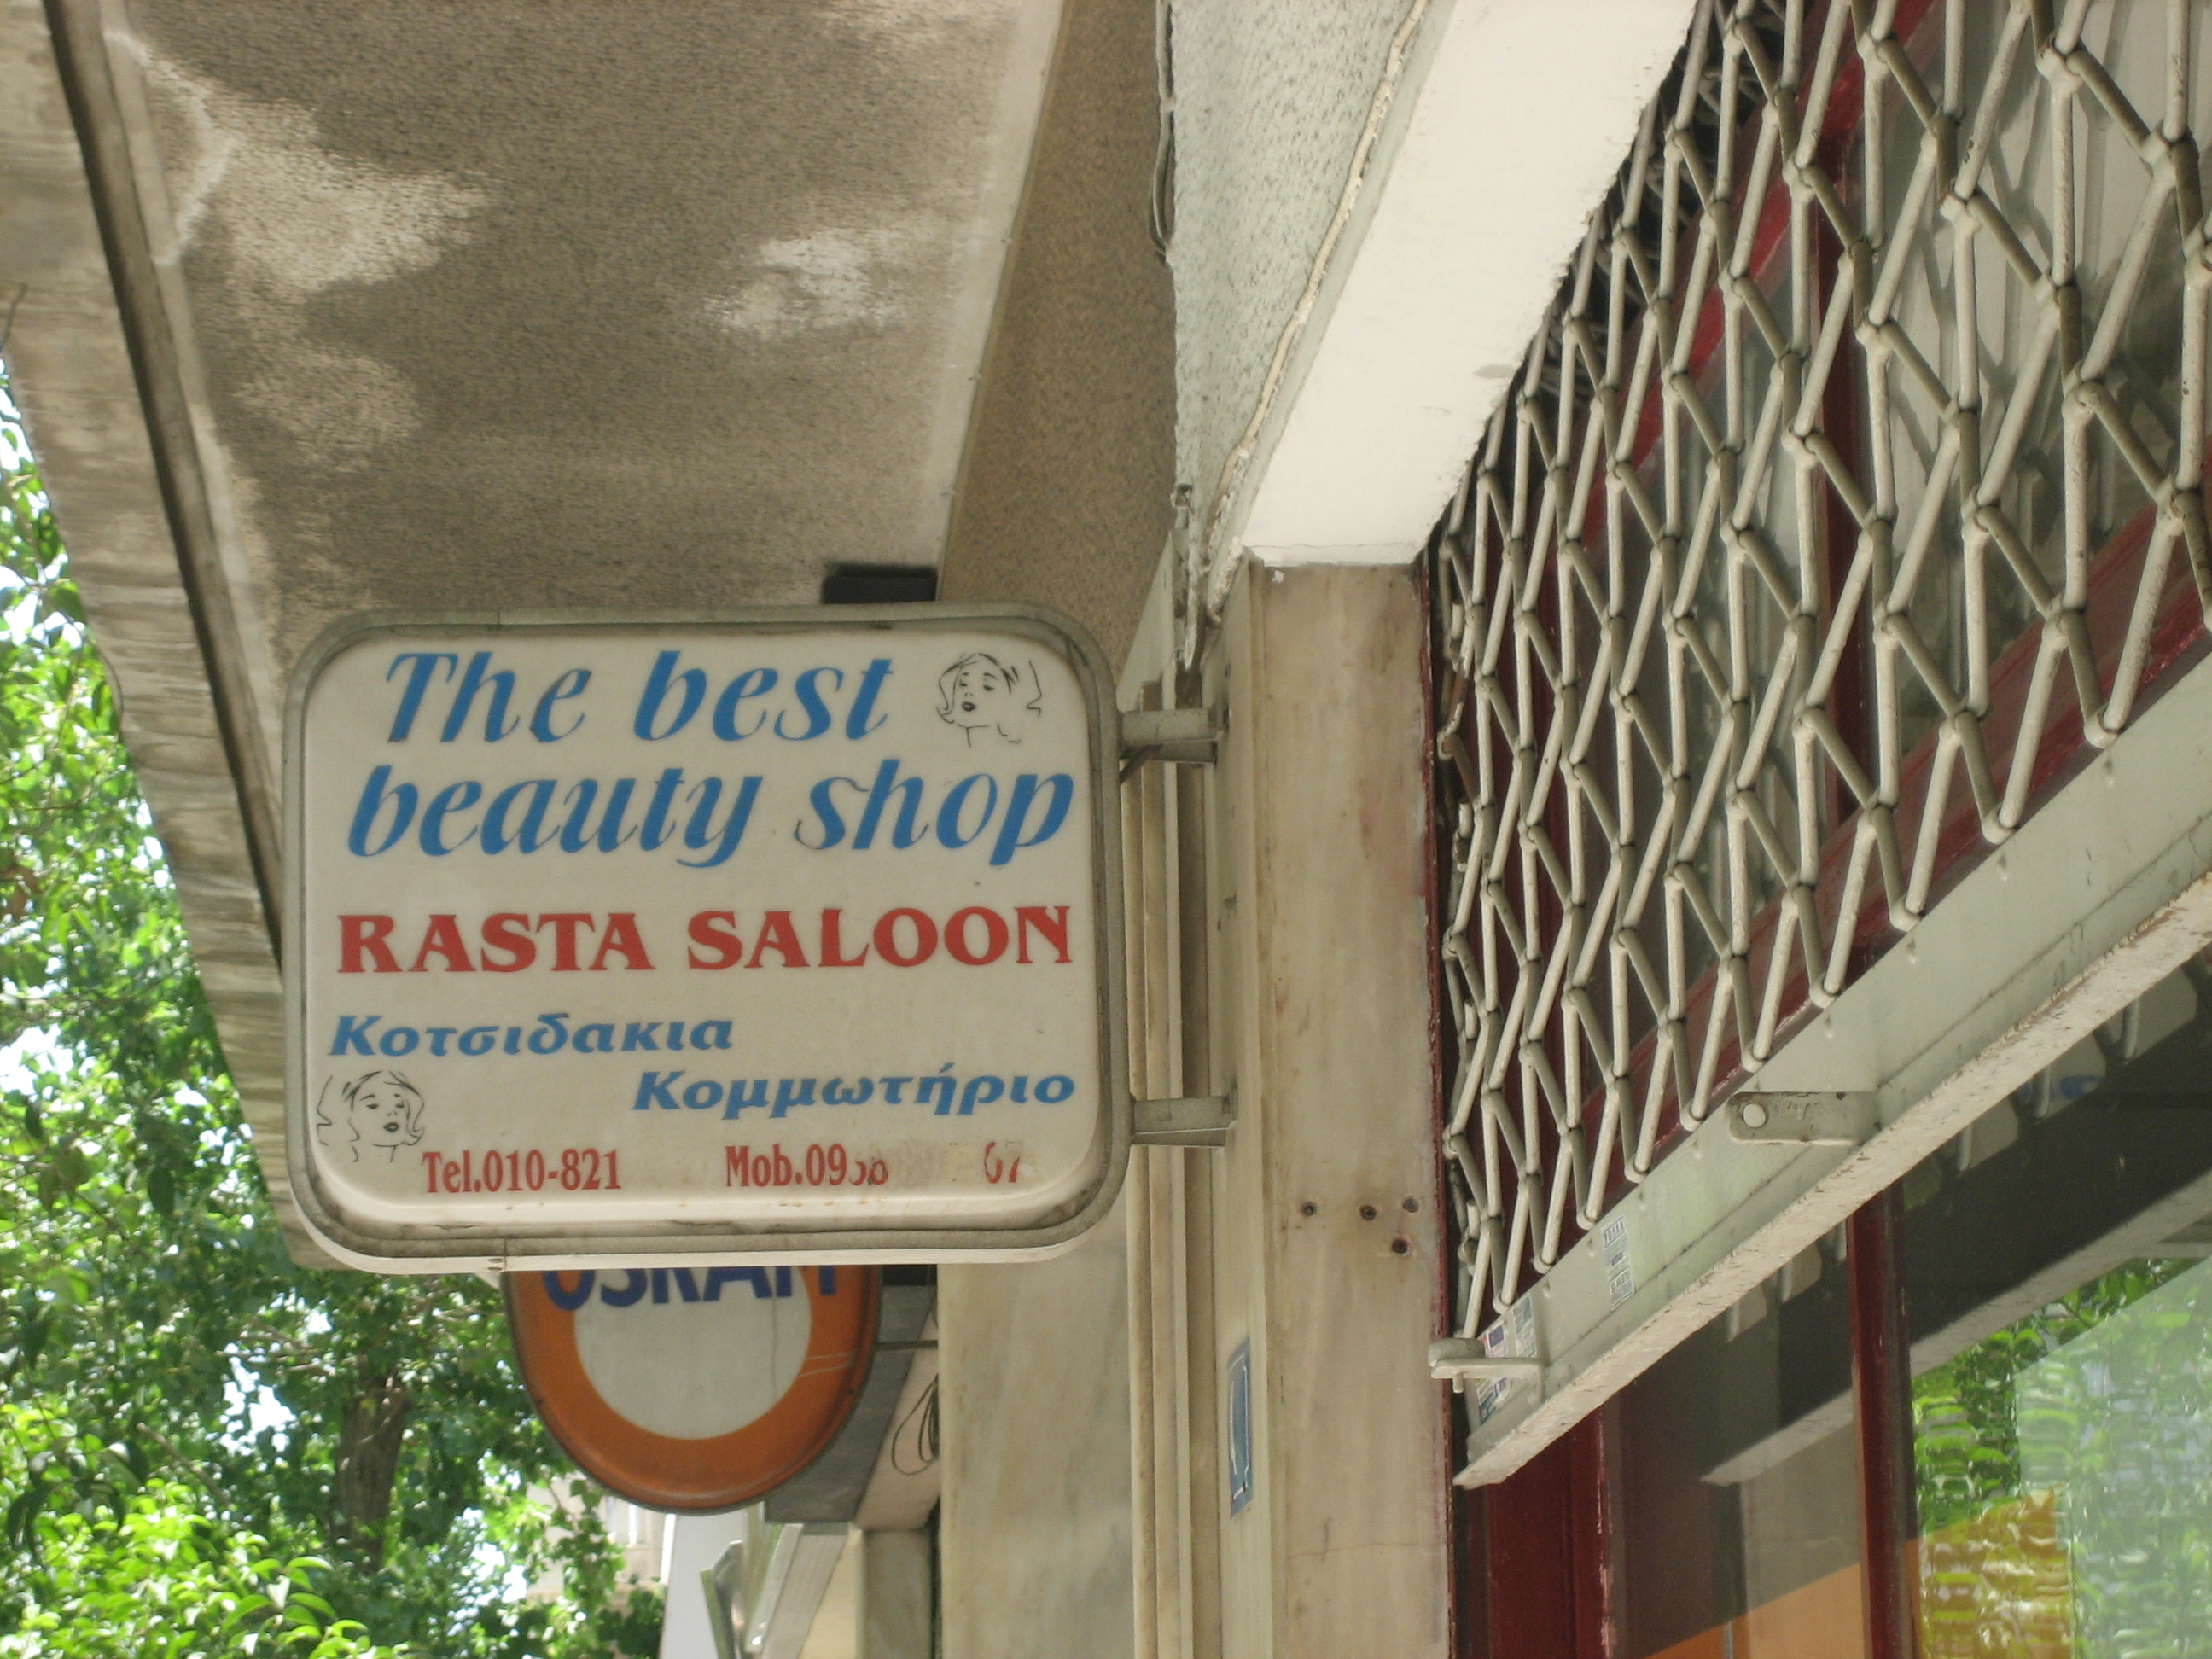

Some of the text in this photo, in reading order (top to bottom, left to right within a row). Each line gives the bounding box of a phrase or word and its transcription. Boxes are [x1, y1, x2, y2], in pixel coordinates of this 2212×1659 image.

[386, 650, 893, 742] The best
[347, 759, 1074, 868] beauty shop
[338, 905, 1073, 974] RASTA SALOON
[329, 1013, 734, 1057] Κοτσιδακια
[632, 1062, 1075, 1120] Κομμωτήριο
[422, 1148, 621, 1193] Tel.010-821
